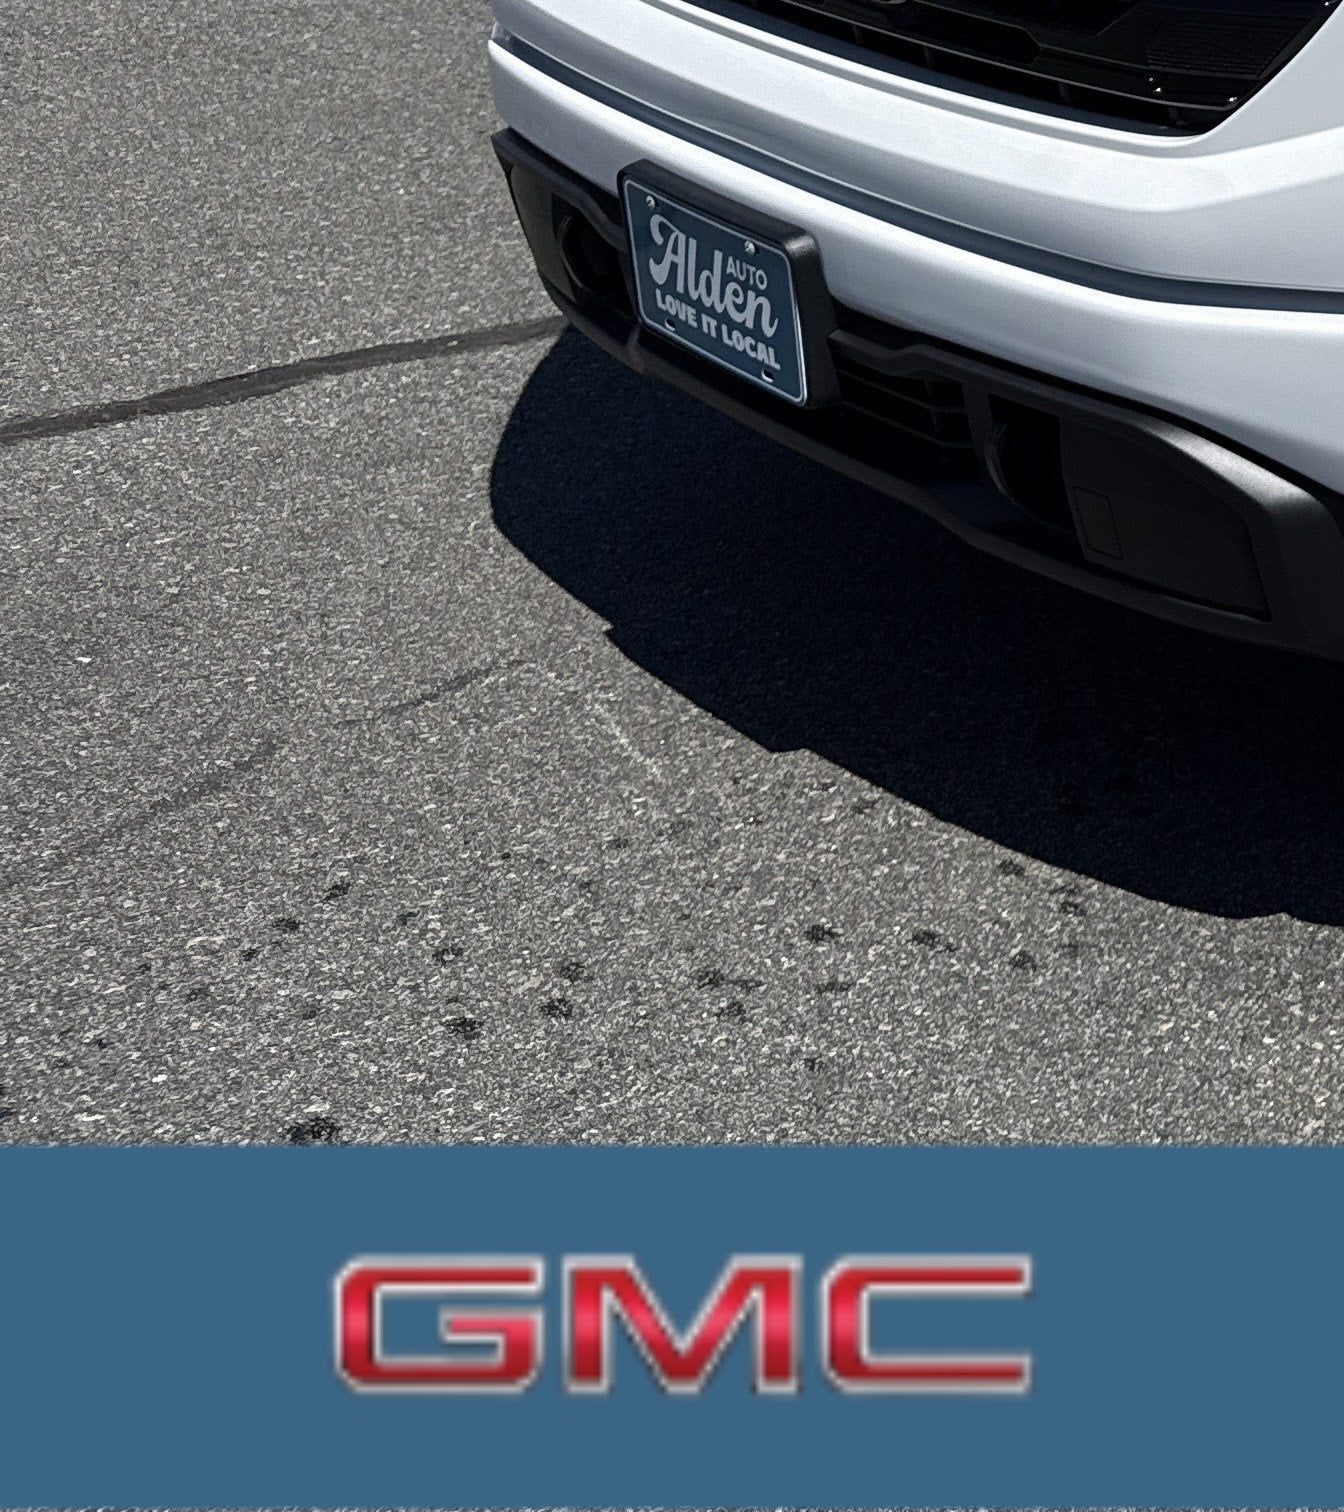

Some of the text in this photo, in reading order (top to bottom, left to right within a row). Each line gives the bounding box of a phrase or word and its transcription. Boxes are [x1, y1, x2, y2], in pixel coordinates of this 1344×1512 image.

[649, 213, 780, 339] Alden
[725, 255, 769, 291] AUTO
[655, 287, 782, 371] LOVE IT LOCAL
